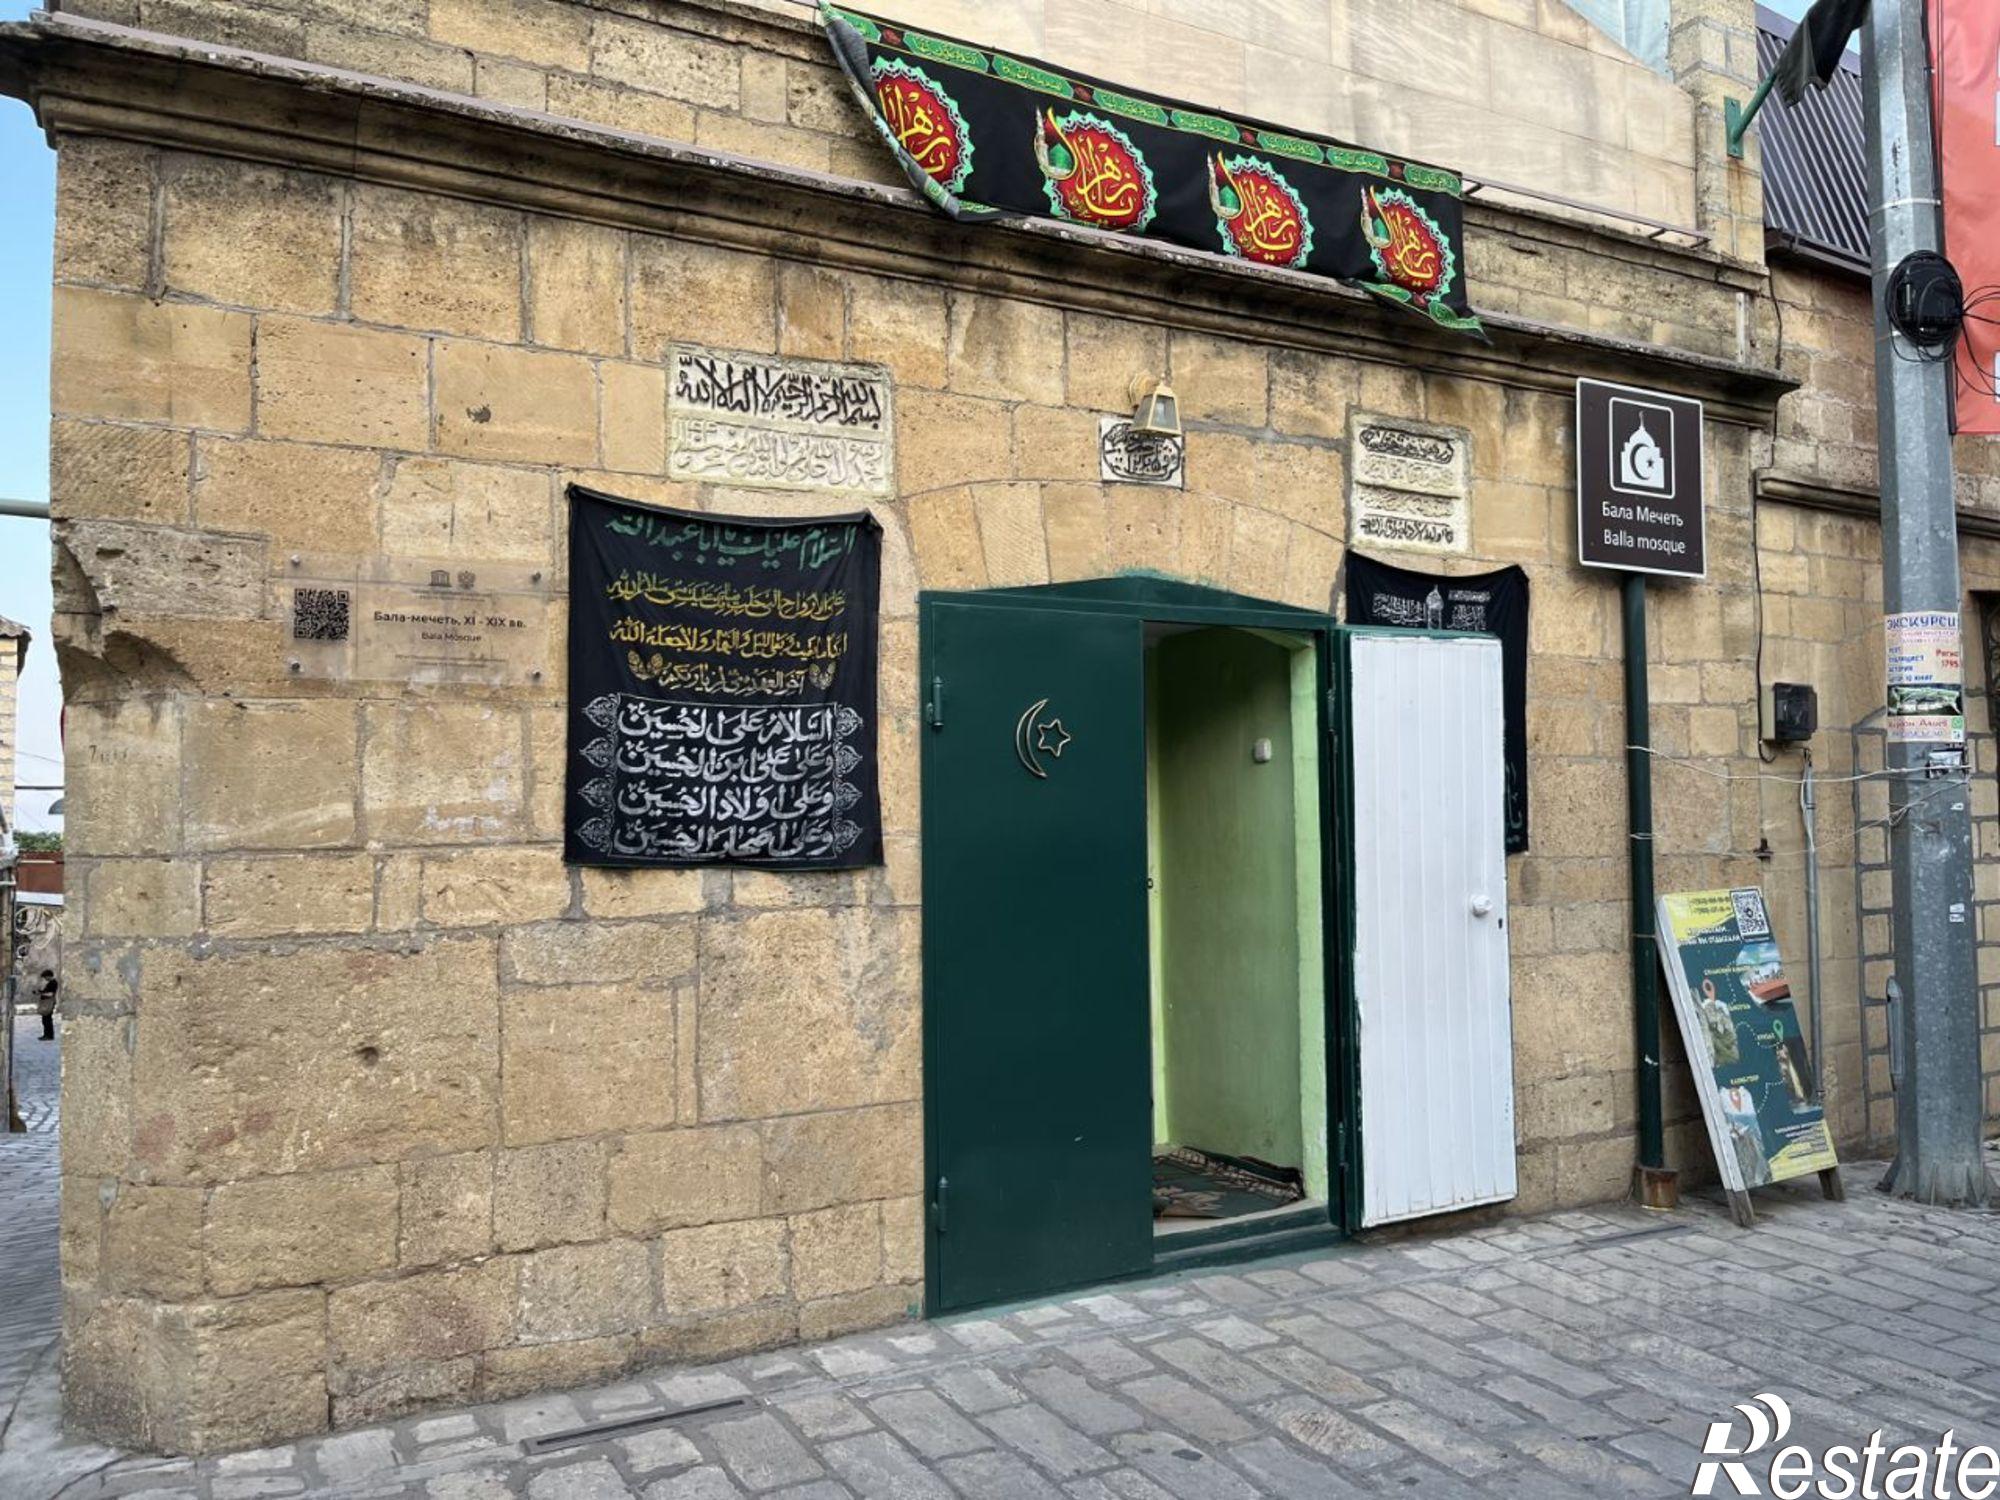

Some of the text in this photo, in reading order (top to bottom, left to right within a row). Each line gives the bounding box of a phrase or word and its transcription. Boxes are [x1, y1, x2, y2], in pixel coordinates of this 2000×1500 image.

[1602, 501, 1684, 527] Бала Мечеть
[1603, 529, 1686, 556] Balla mosque
[373, 610, 461, 626] Бала-мечеть,
[618, 702, 728, 740] الحسين
[756, 707, 834, 745] السلام
[615, 740, 718, 778] الحسين
[617, 780, 719, 817] الحسين
